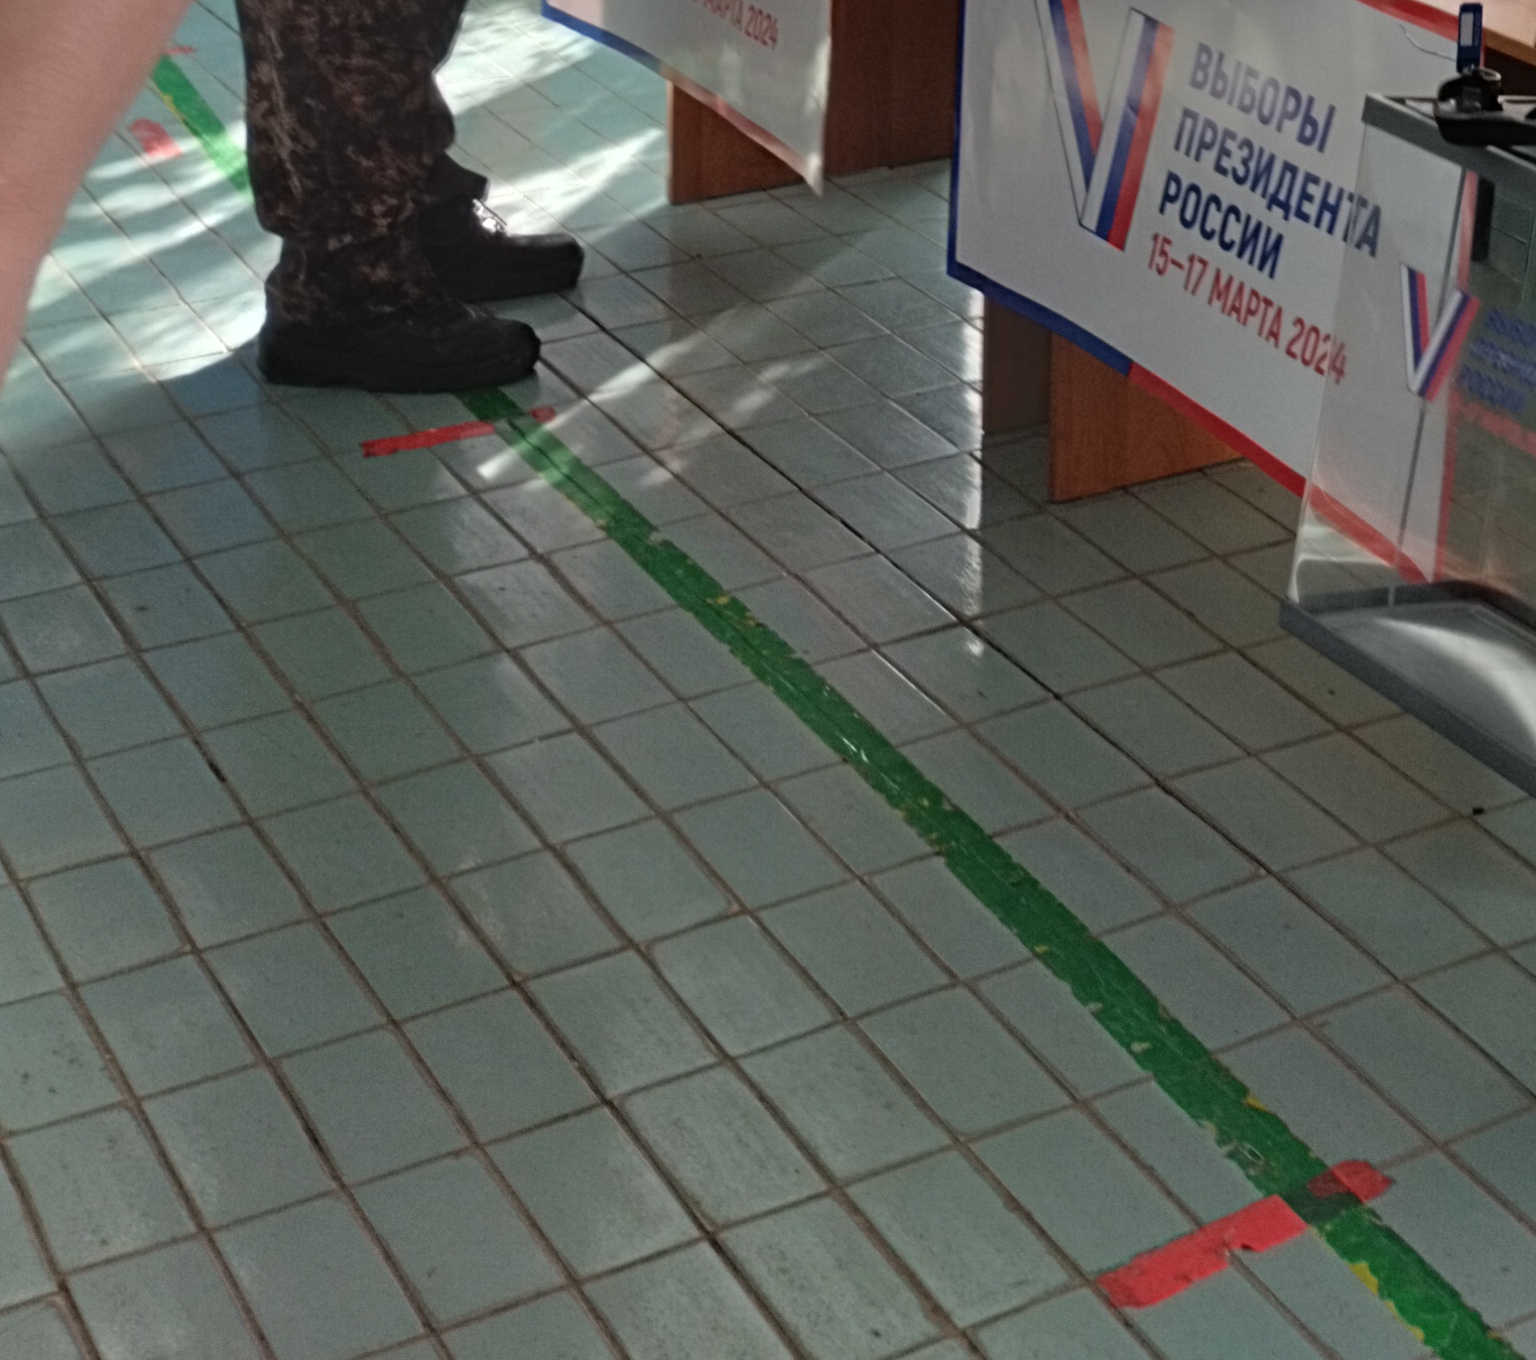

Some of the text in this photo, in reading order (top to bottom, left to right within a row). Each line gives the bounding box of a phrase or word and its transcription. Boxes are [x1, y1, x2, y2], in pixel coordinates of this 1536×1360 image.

[743, 3, 778, 50] 2024
[1188, 41, 1337, 154] ВЫБОРЫ
[1158, 170, 1286, 281] РОССИИ
[1173, 107, 1382, 259] ПРЕЗИДЕНТА
[1207, 266, 1284, 350] МАРТА
[1284, 315, 1347, 386] 2024
